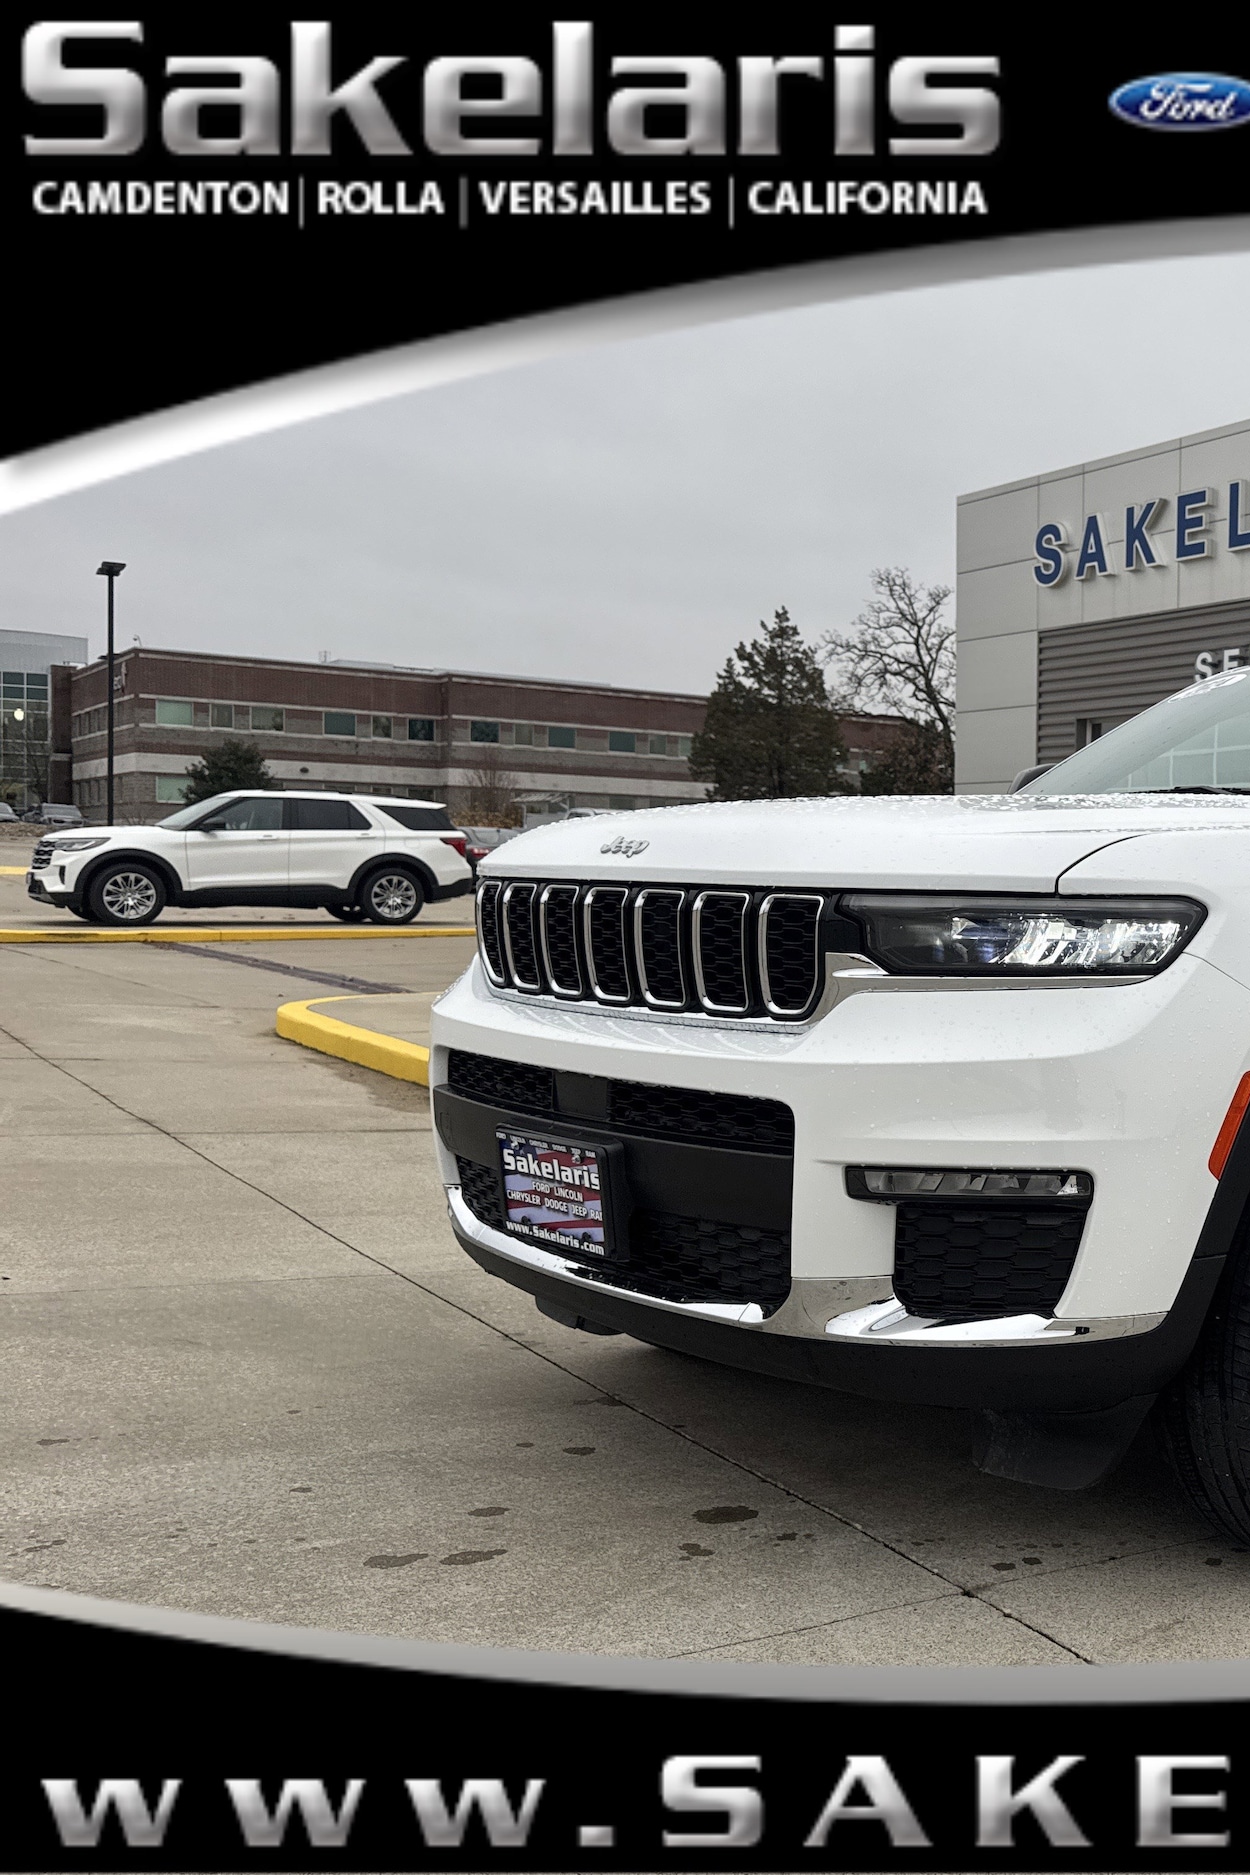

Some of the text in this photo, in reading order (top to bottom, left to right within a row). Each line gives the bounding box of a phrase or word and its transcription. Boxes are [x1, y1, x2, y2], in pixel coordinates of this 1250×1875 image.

[600, 836, 650, 858] Jeep
[503, 1149, 600, 1190] Sakelaris
[507, 1189, 541, 1205] CHRYSLER
[545, 1198, 568, 1212] DODGE
[571, 1204, 588, 1218] JEEP
[532, 1181, 583, 1202] FORD LINCOLN
[506, 1221, 604, 1255] www.Sakelaris.com
